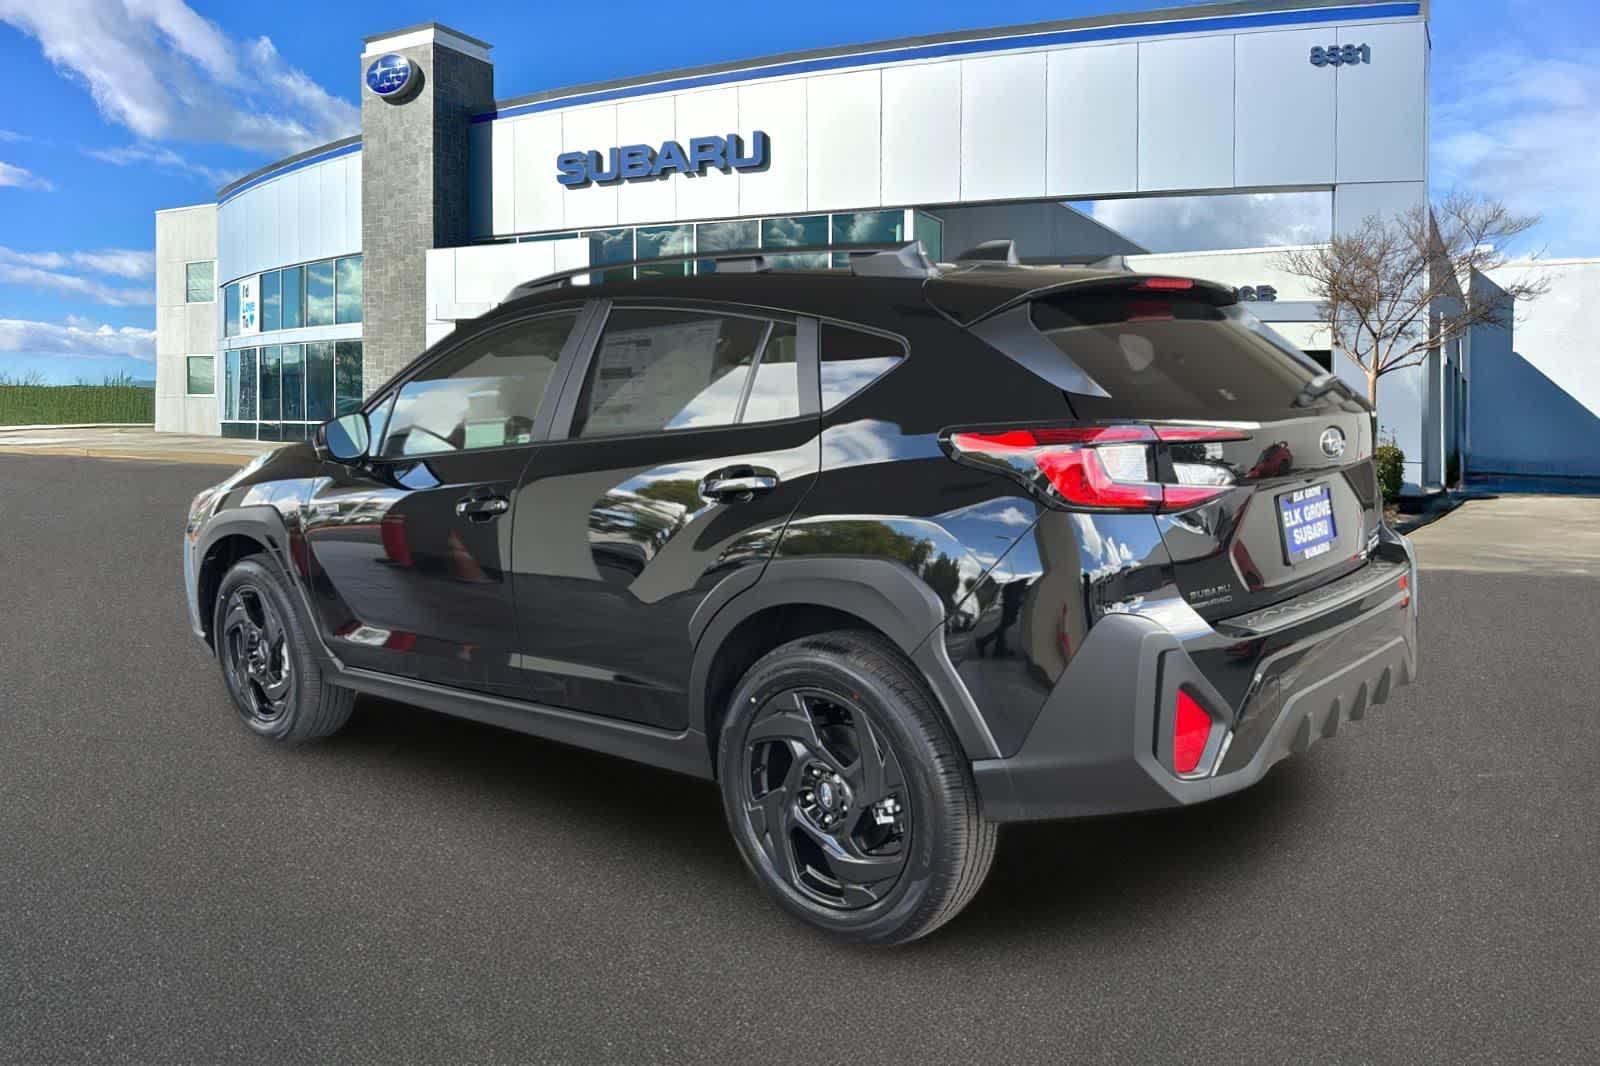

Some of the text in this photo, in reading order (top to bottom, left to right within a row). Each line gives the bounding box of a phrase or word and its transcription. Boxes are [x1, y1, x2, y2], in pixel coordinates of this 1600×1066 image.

[556, 130, 769, 189] SUBARU
[1283, 499, 1332, 528] ELK GROVE
[1293, 519, 1329, 545] SUBARU
[1189, 584, 1232, 601] SUBARU
